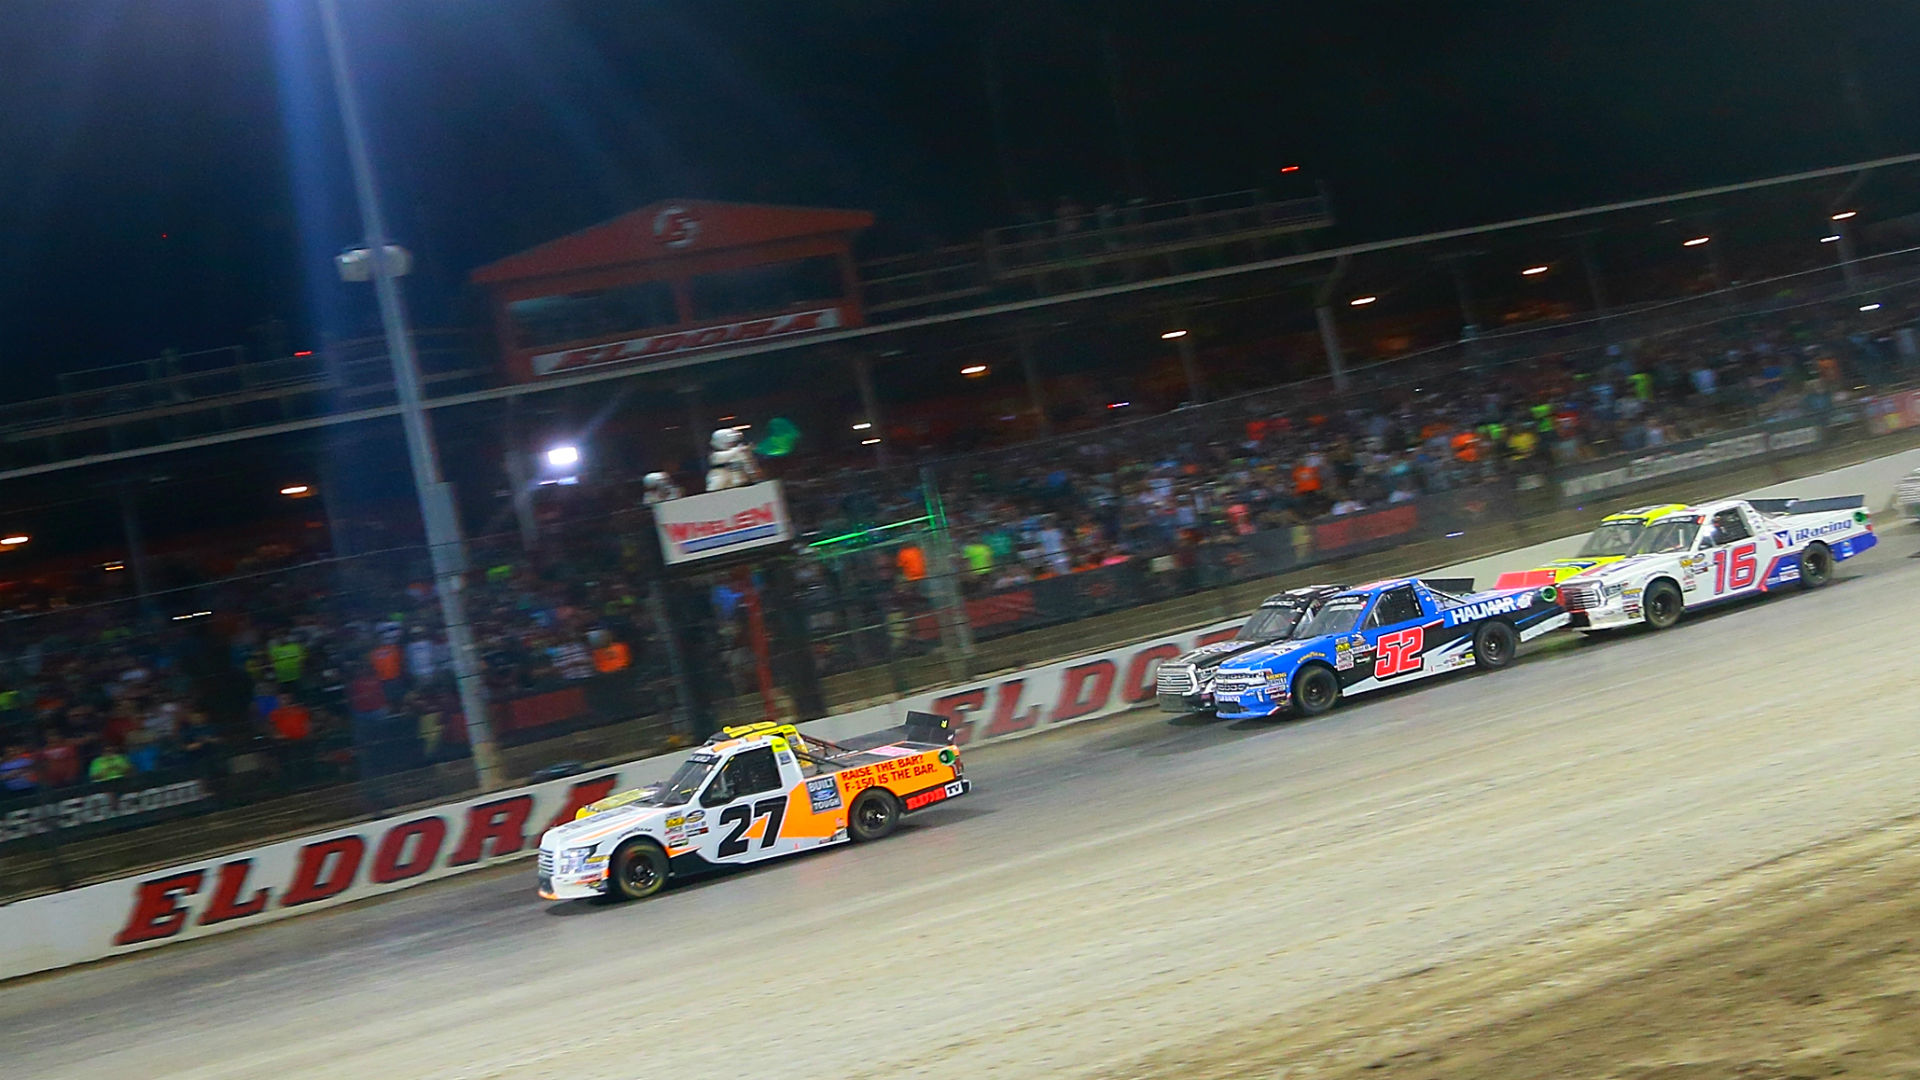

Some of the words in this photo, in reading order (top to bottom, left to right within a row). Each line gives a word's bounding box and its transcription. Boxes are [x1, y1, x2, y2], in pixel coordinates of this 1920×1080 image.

[1796, 519, 1852, 541] iRacing
[1713, 542, 1757, 595] 16
[1451, 596, 1517, 625] HALMAR
[1374, 626, 1424, 681] 52
[841, 766, 873, 781] RAISE
[875, 760, 895, 775] THE
[898, 754, 924, 769] BAR?
[844, 776, 875, 793] F-150
[878, 774, 889, 785] IS
[890, 768, 911, 783] THE
[913, 763, 938, 777] BAR.
[807, 777, 835, 792] BUILT
[813, 798, 840, 811] TOUGH
[717, 795, 788, 859] 27
